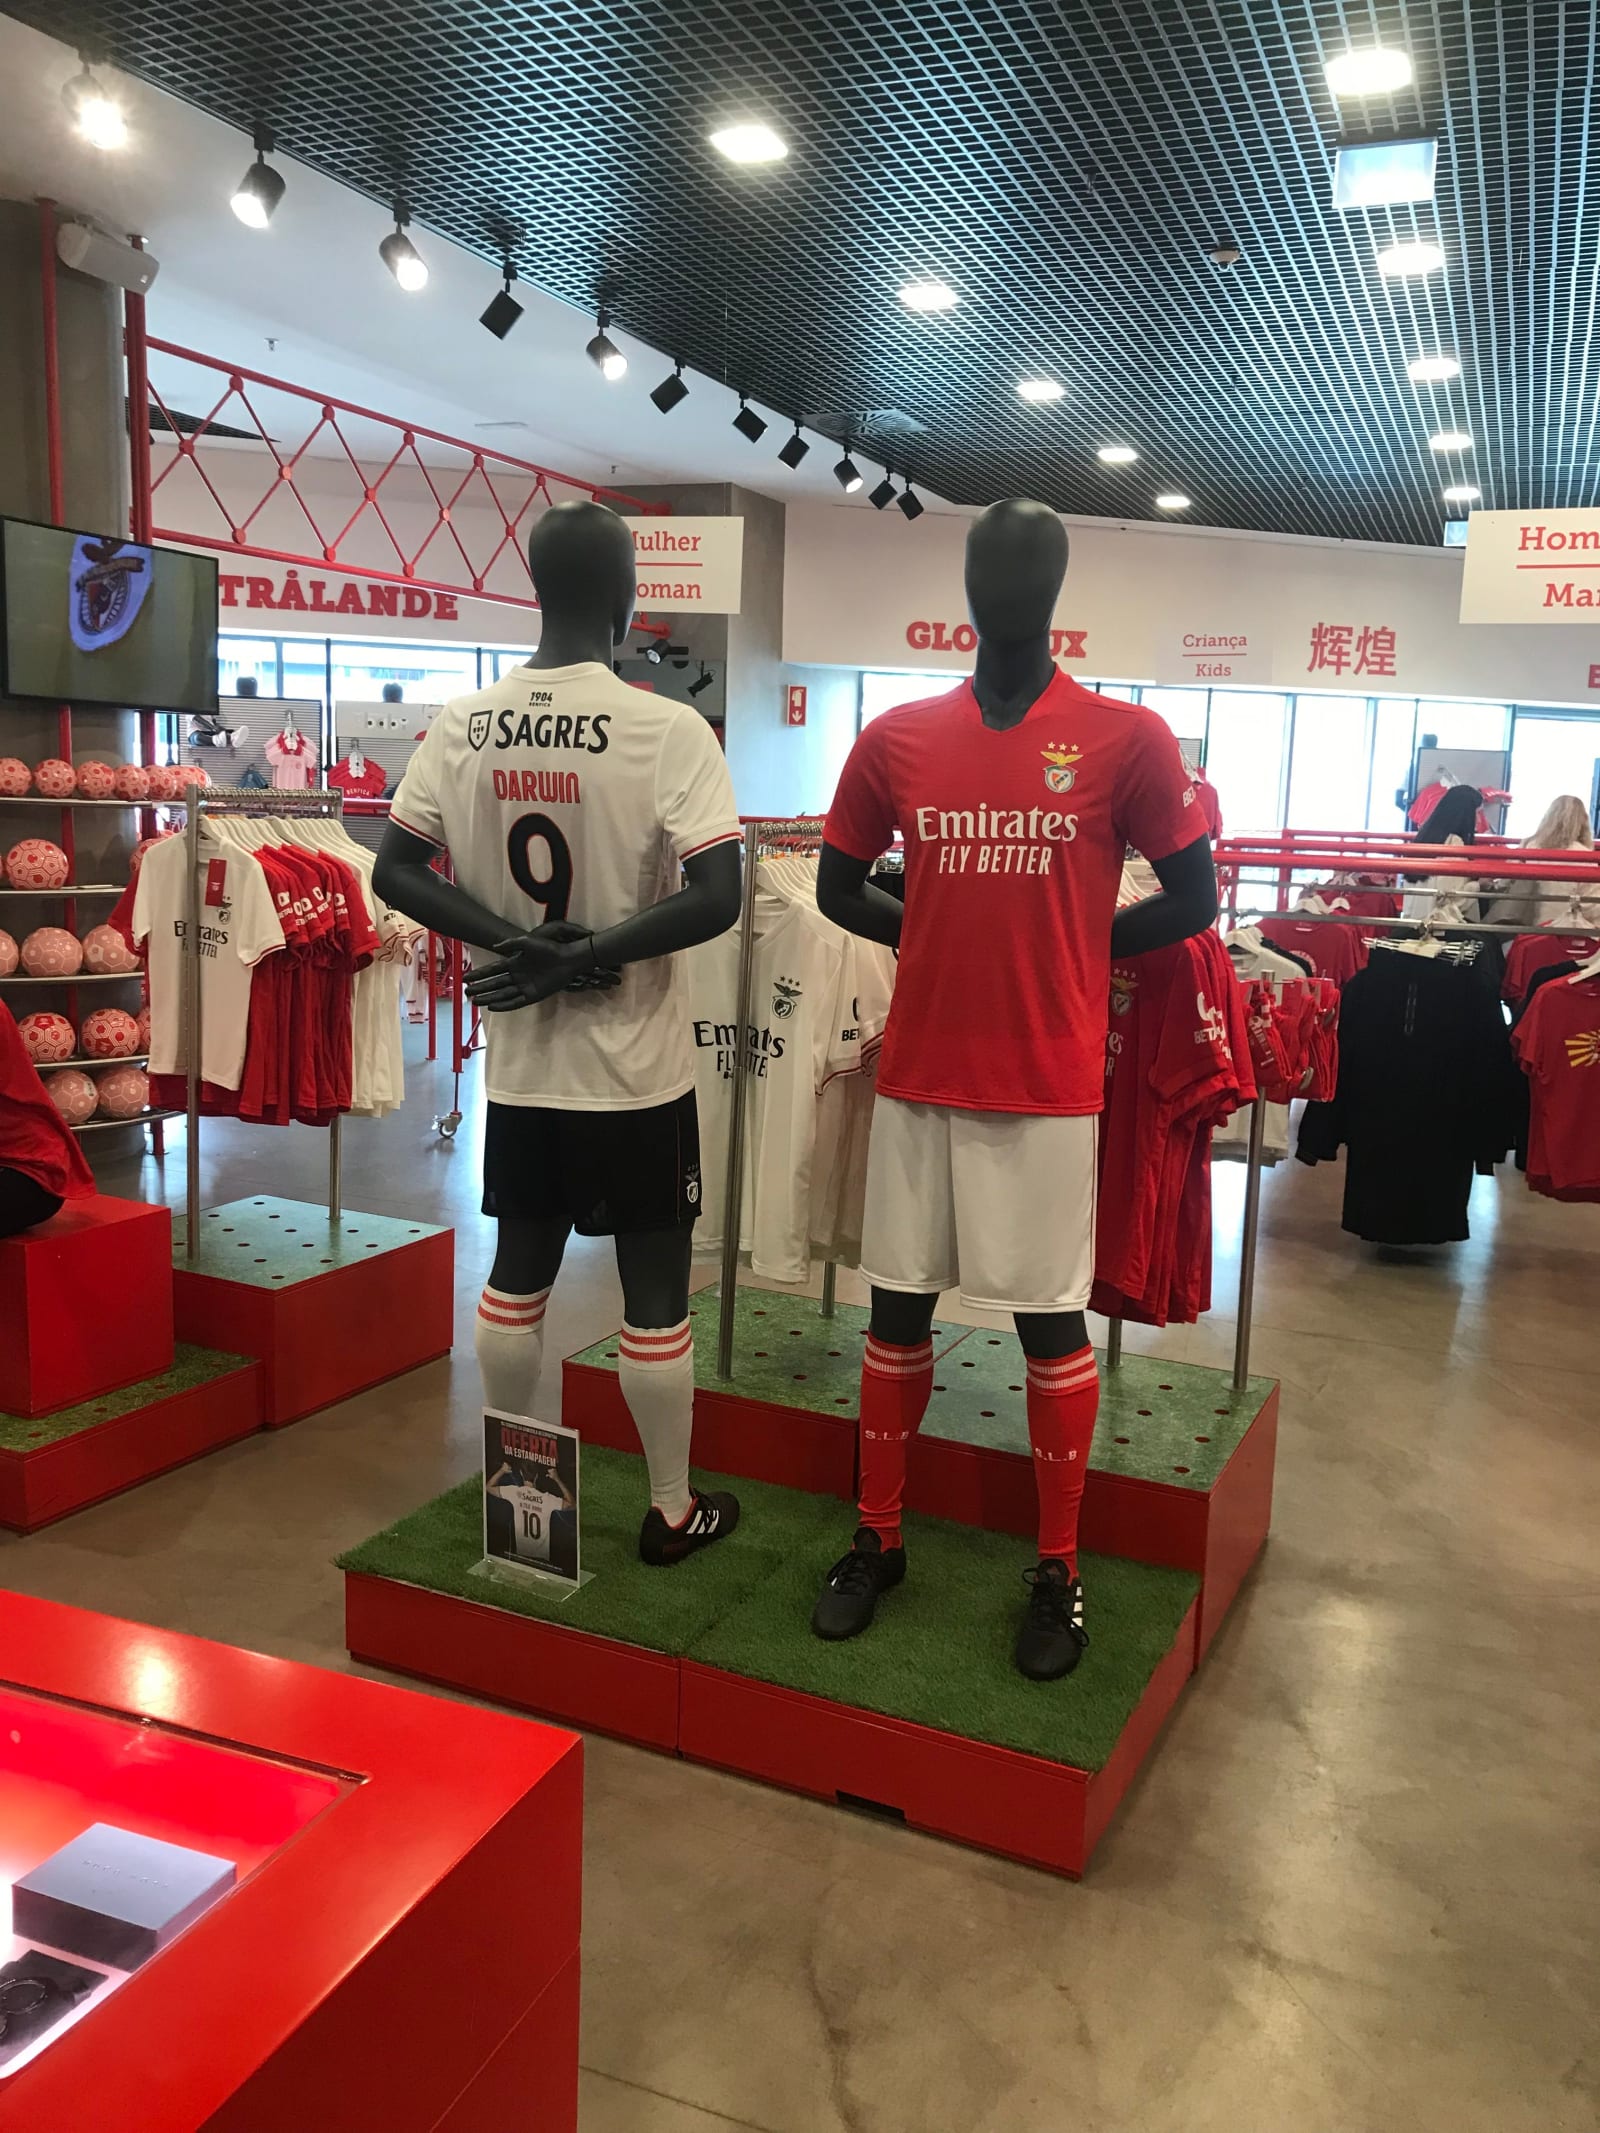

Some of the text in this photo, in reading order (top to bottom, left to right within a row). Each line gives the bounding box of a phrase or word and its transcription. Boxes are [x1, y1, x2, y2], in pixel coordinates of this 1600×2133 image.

[219, 570, 458, 620] TRÅLANDE
[636, 583, 702, 599] oman
[1543, 583, 1600, 607] Ma
[1182, 634, 1247, 650] Criança
[1307, 622, 1397, 676] 辉煌
[1195, 664, 1232, 677] Kids
[530, 691, 553, 702] 1904
[495, 709, 612, 754] SAGRES
[493, 769, 581, 804] DARWIN
[916, 802, 1079, 842] Emirates
[507, 812, 573, 924] 9
[938, 845, 1053, 875] FLY BETTER
[514, 1447, 557, 1468] ESTAMPAGEM
[522, 1510, 541, 1539] 10
